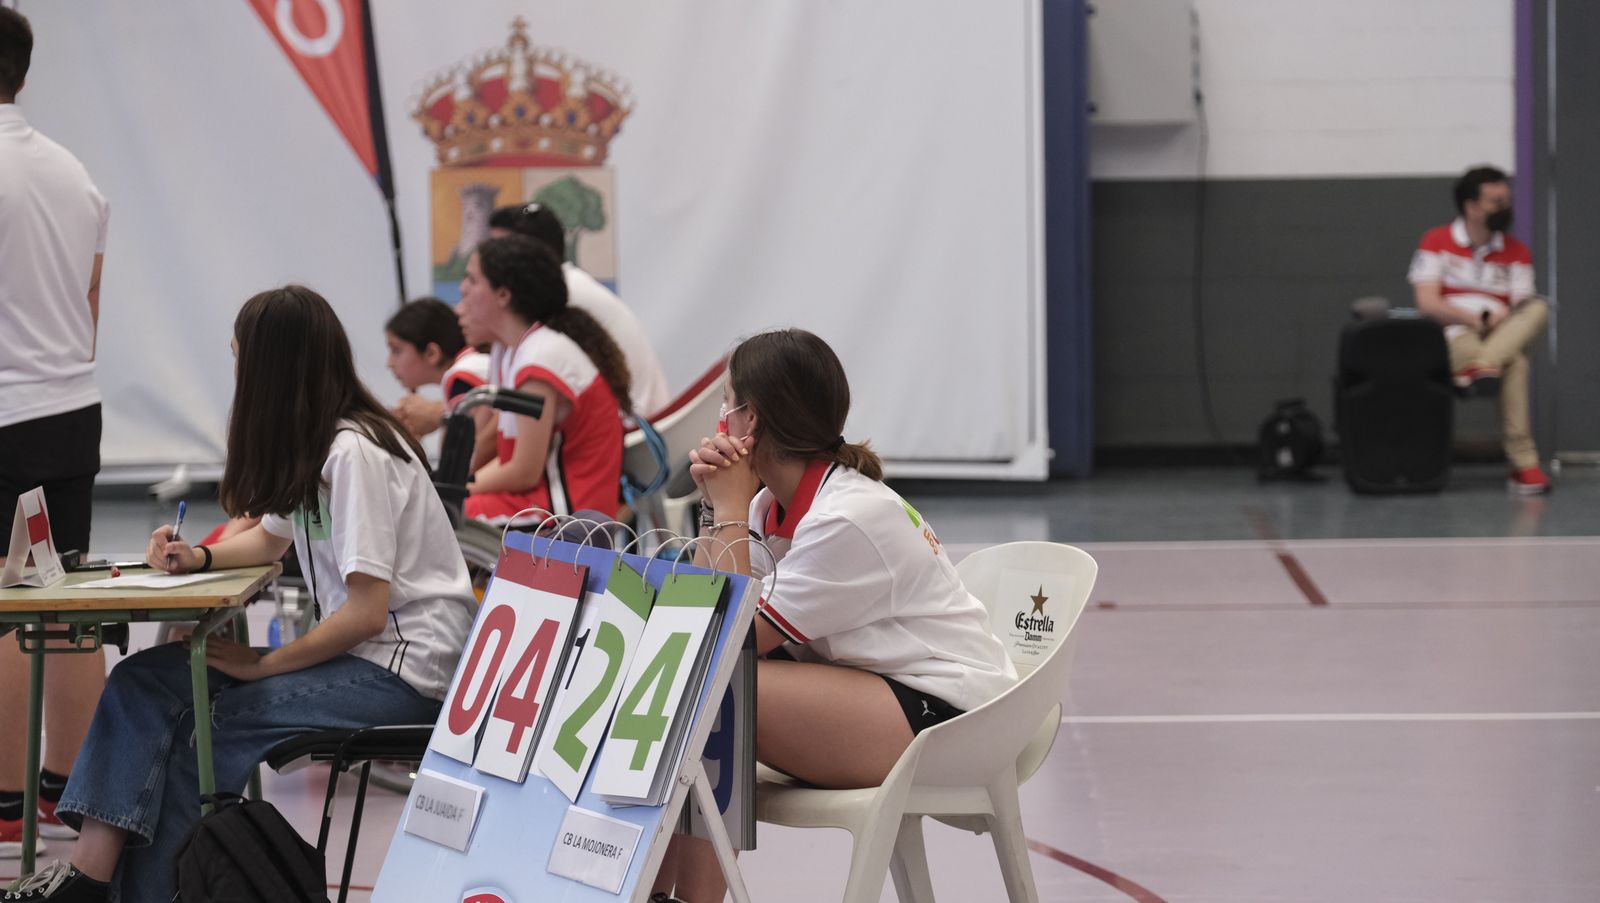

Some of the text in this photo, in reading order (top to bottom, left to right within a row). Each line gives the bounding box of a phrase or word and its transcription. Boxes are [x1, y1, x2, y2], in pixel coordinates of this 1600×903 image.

[1015, 611, 1054, 632] Estrella
[448, 604, 560, 754] 04
[553, 621, 692, 773] 24
[416, 794, 426, 810] CB
[425, 797, 434, 813] LA
[563, 832, 623, 860] CB LA MOJONERA F
